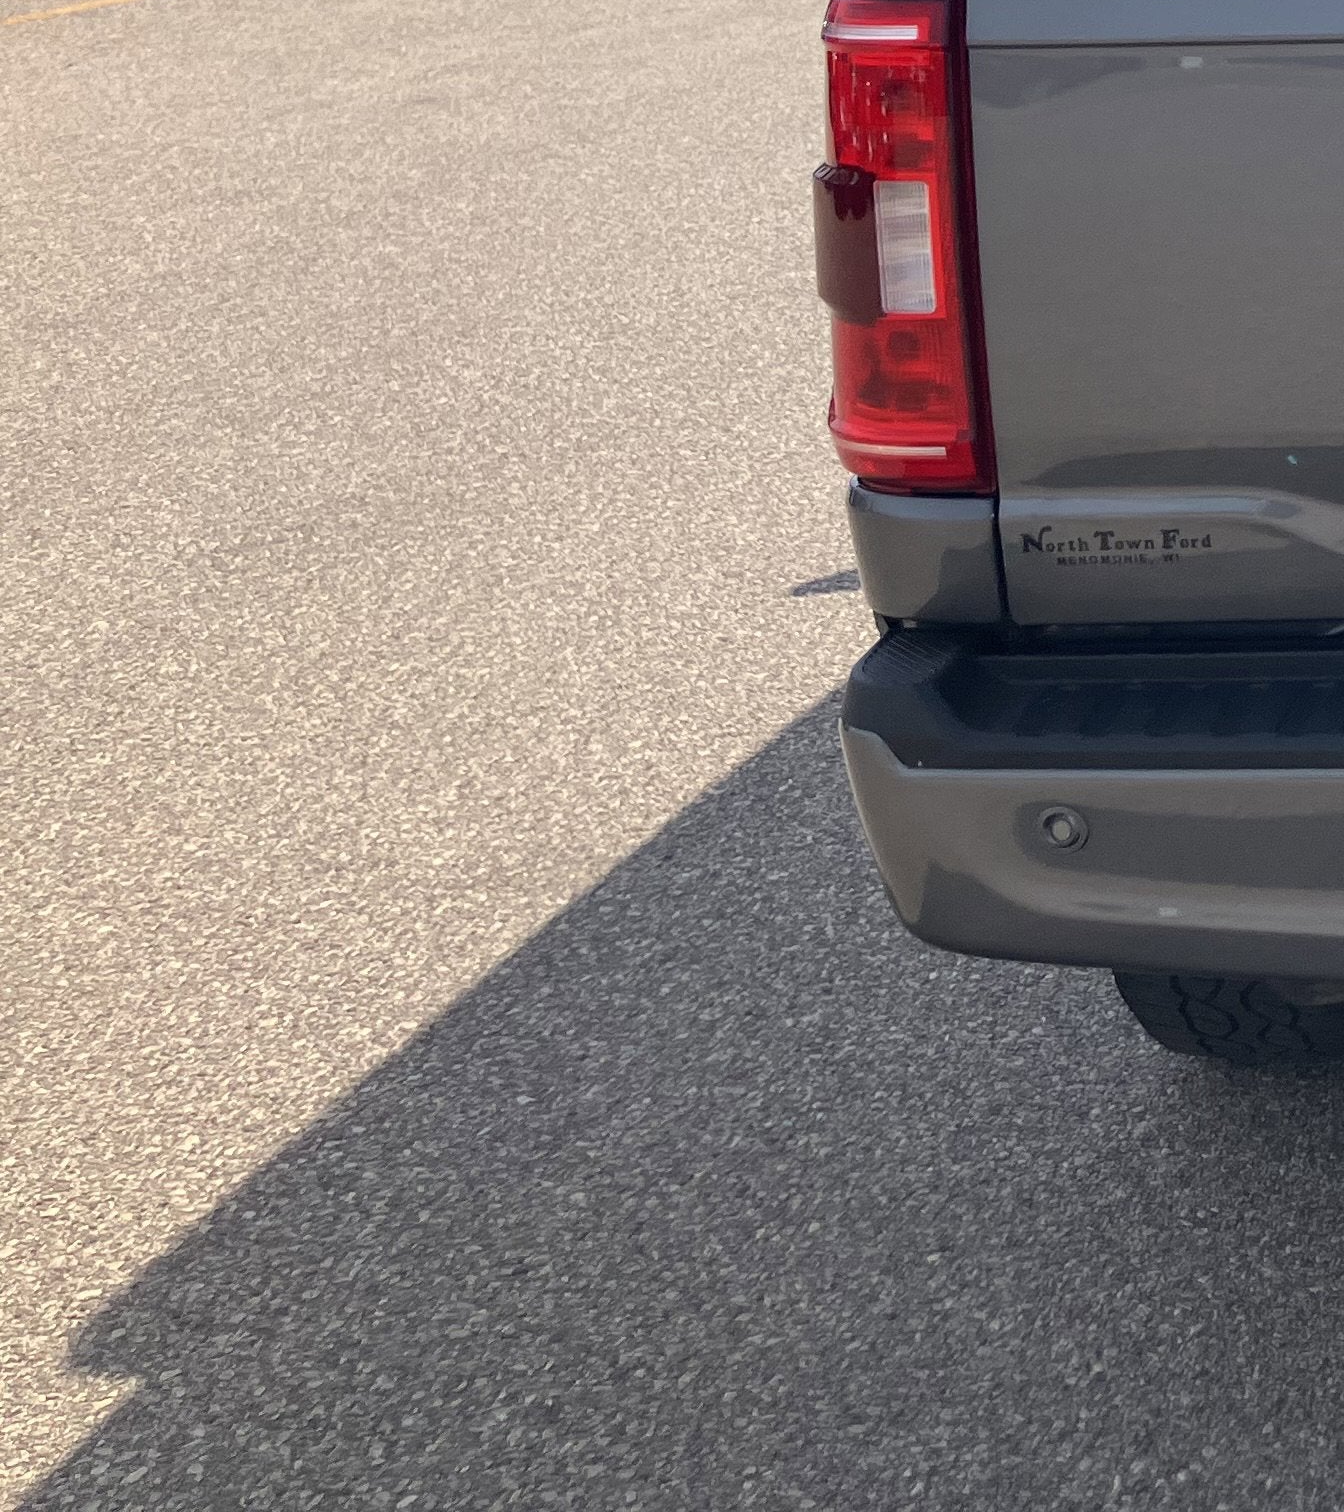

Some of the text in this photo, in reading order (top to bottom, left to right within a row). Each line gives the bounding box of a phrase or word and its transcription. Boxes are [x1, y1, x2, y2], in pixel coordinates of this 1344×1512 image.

[1021, 525, 1212, 553] North Town Ford
